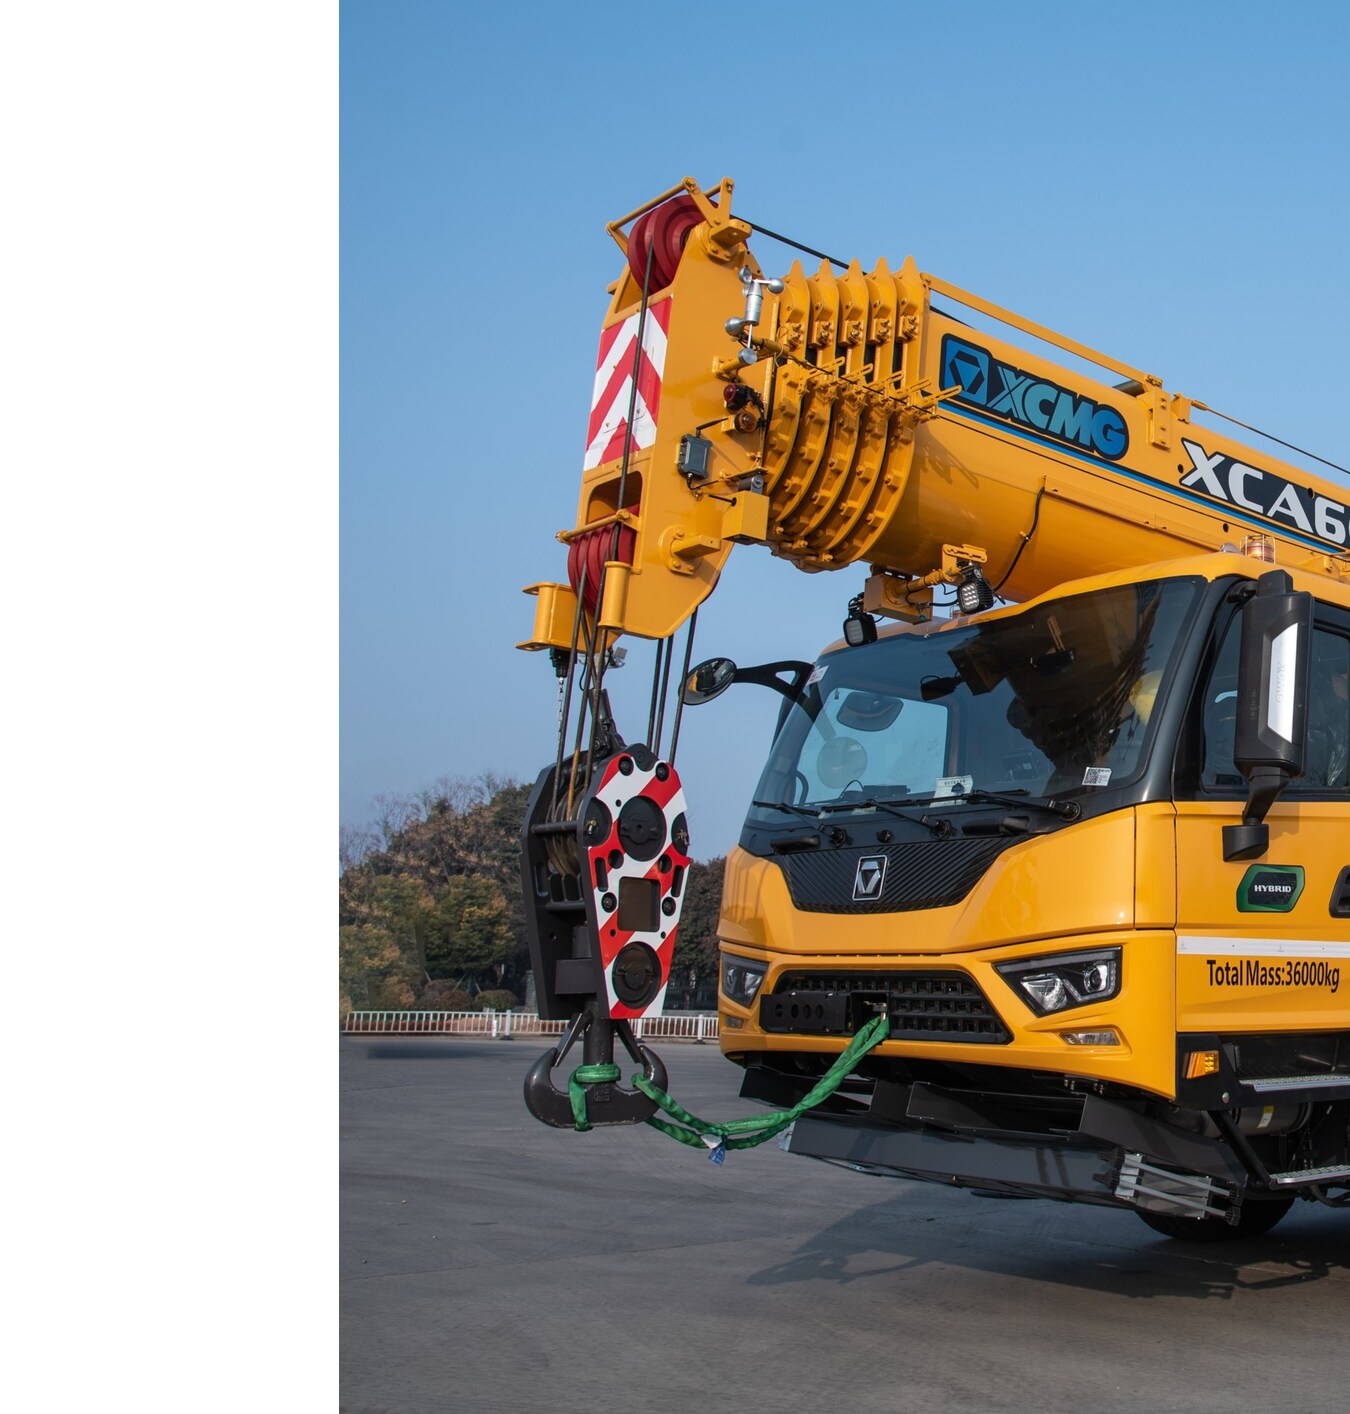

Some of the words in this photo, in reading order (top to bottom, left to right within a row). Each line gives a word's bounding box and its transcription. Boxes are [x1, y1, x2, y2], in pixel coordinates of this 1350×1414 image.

[986, 365, 1126, 456] XCMG
[1254, 884, 1292, 893] HYBRID
[1206, 959, 1243, 987] Total
[1246, 960, 1340, 993] Mass:36000kg
